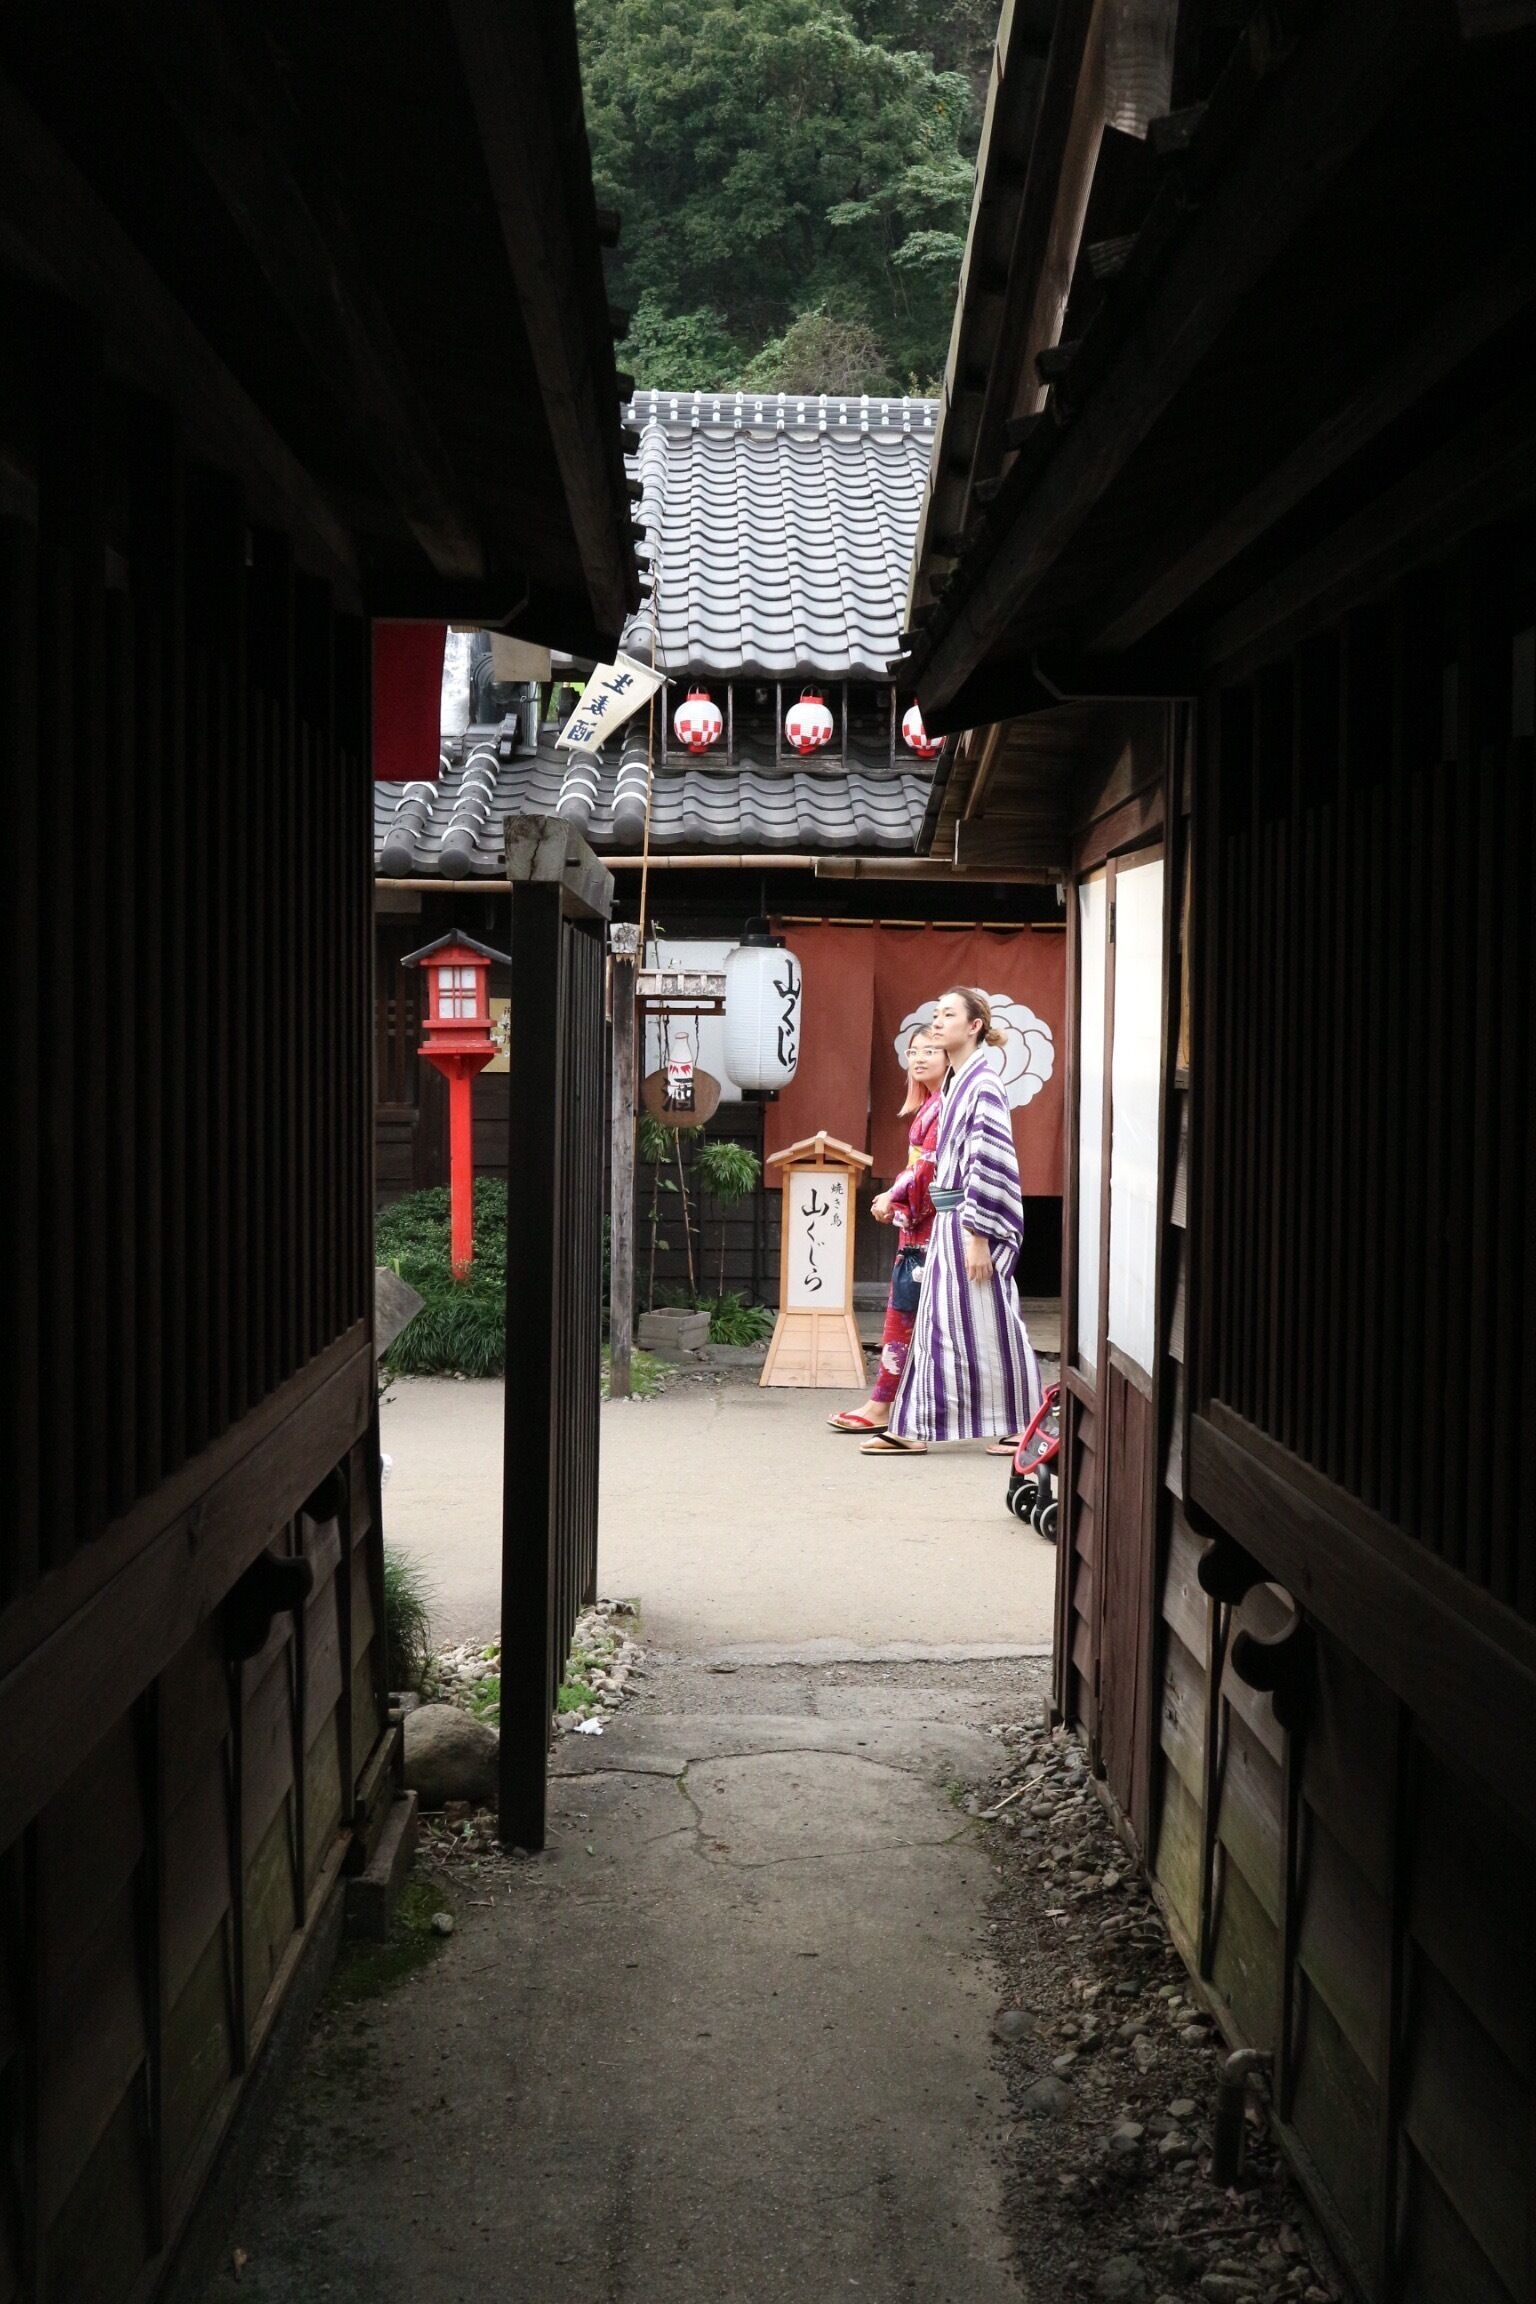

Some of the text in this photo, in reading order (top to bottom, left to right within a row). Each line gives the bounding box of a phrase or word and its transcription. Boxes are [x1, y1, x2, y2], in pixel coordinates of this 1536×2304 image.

[773, 958, 801, 1073] 山くじら
[661, 1077, 696, 1113] 酒
[801, 1188, 830, 1292] 山くじら
[831, 1181, 845, 1228] 焼き鳥
